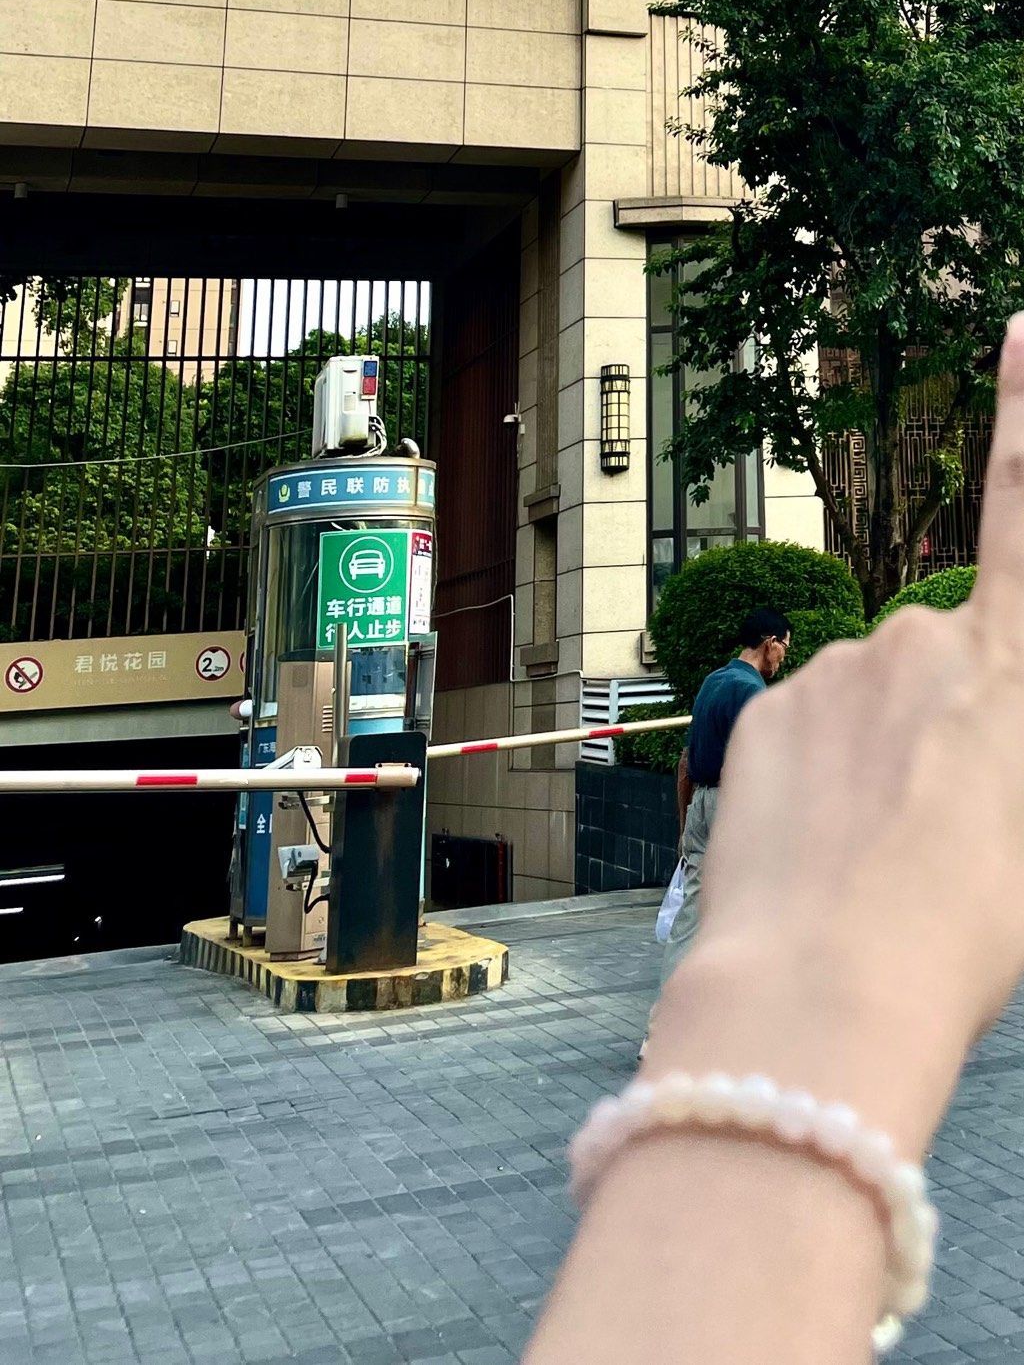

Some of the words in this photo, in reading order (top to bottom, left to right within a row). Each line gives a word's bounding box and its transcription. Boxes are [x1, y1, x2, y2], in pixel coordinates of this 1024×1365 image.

[326, 596, 402, 619] 车行通道
[74, 651, 167, 674] 君悦花园
[256, 813, 273, 834] 全
